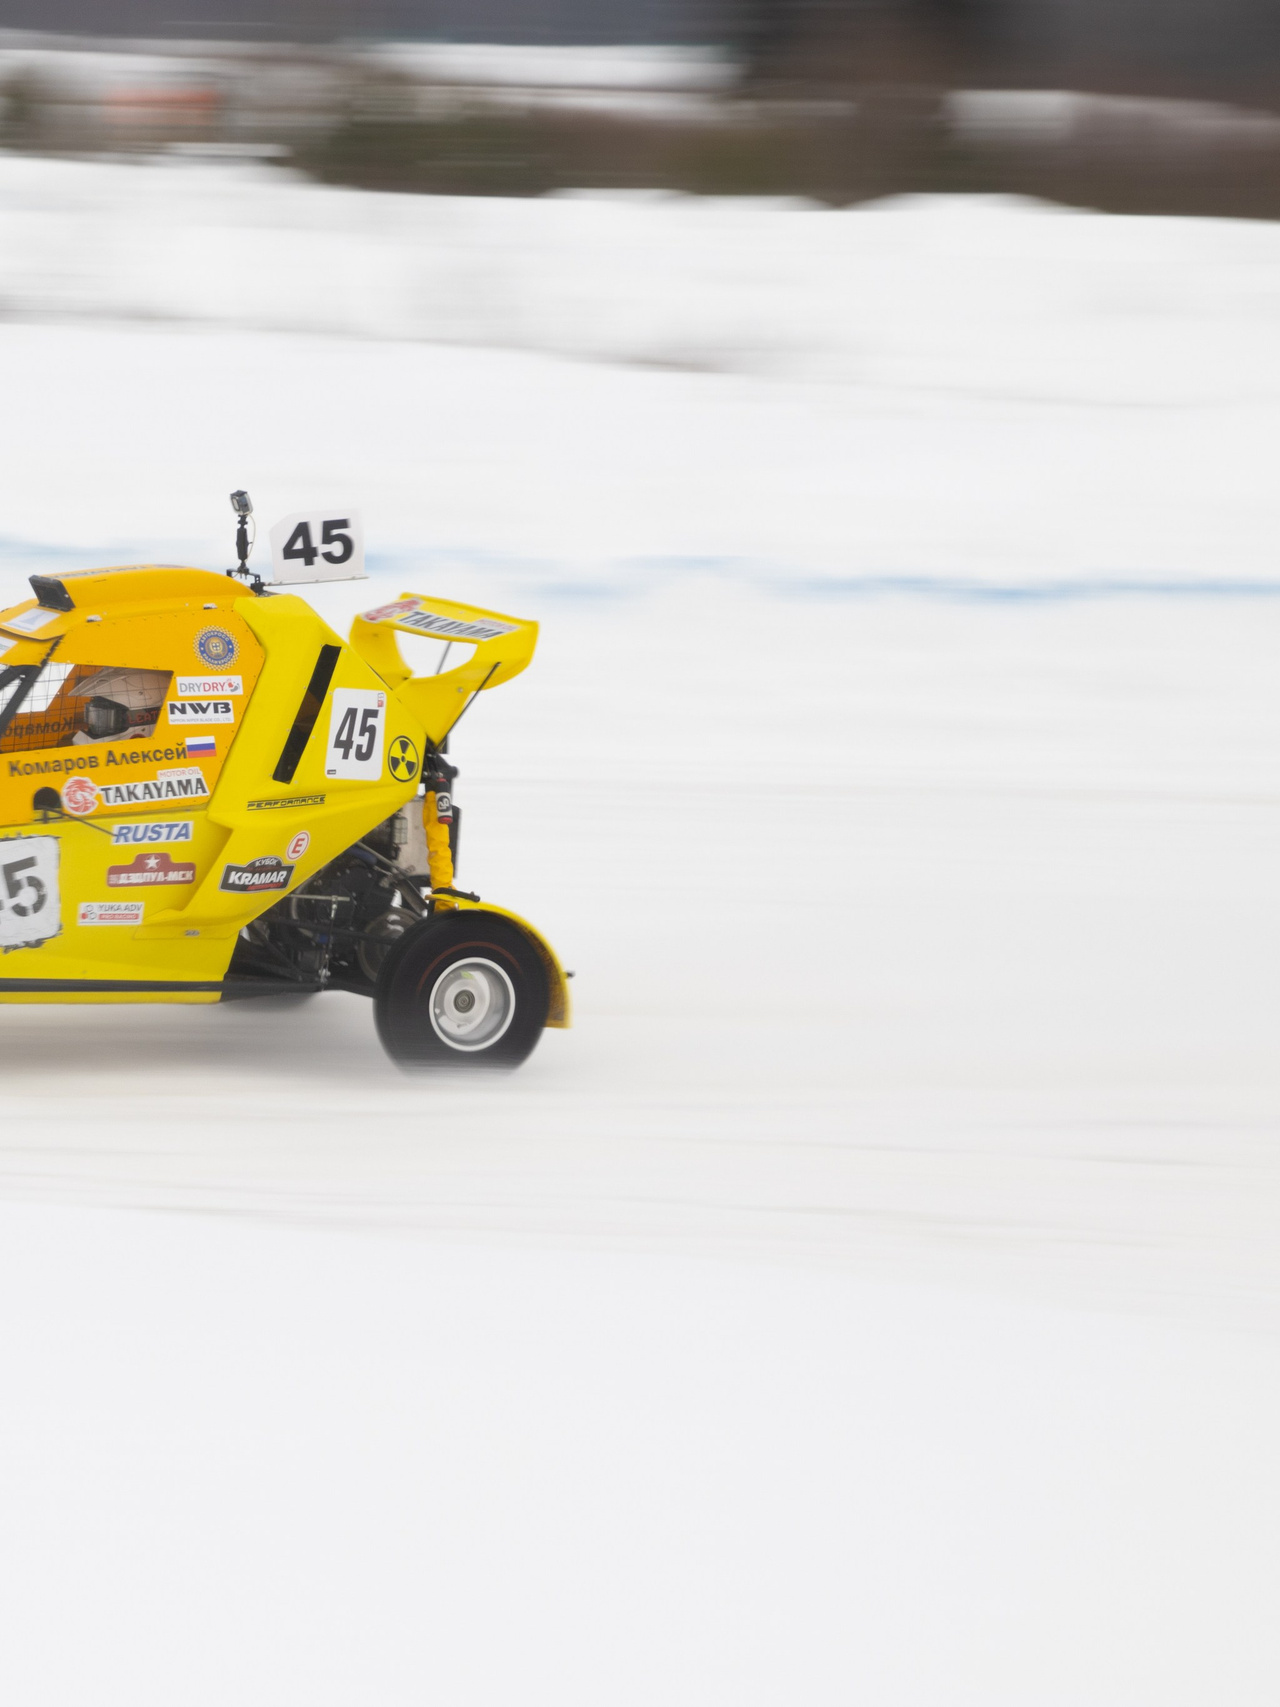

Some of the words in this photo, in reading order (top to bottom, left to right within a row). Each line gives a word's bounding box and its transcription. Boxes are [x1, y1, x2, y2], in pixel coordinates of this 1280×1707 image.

[281, 518, 355, 567] 45
[398, 610, 505, 640] TAKAYAMA
[169, 702, 232, 715] NWB
[333, 707, 379, 761] 45
[8, 756, 98, 777] Комаров
[106, 742, 187, 767] Алексей
[102, 778, 207, 803] TAKAYAMA
[114, 822, 190, 844] RUSTA
[291, 838, 305, 853] E
[228, 870, 287, 885] KRAMAR
